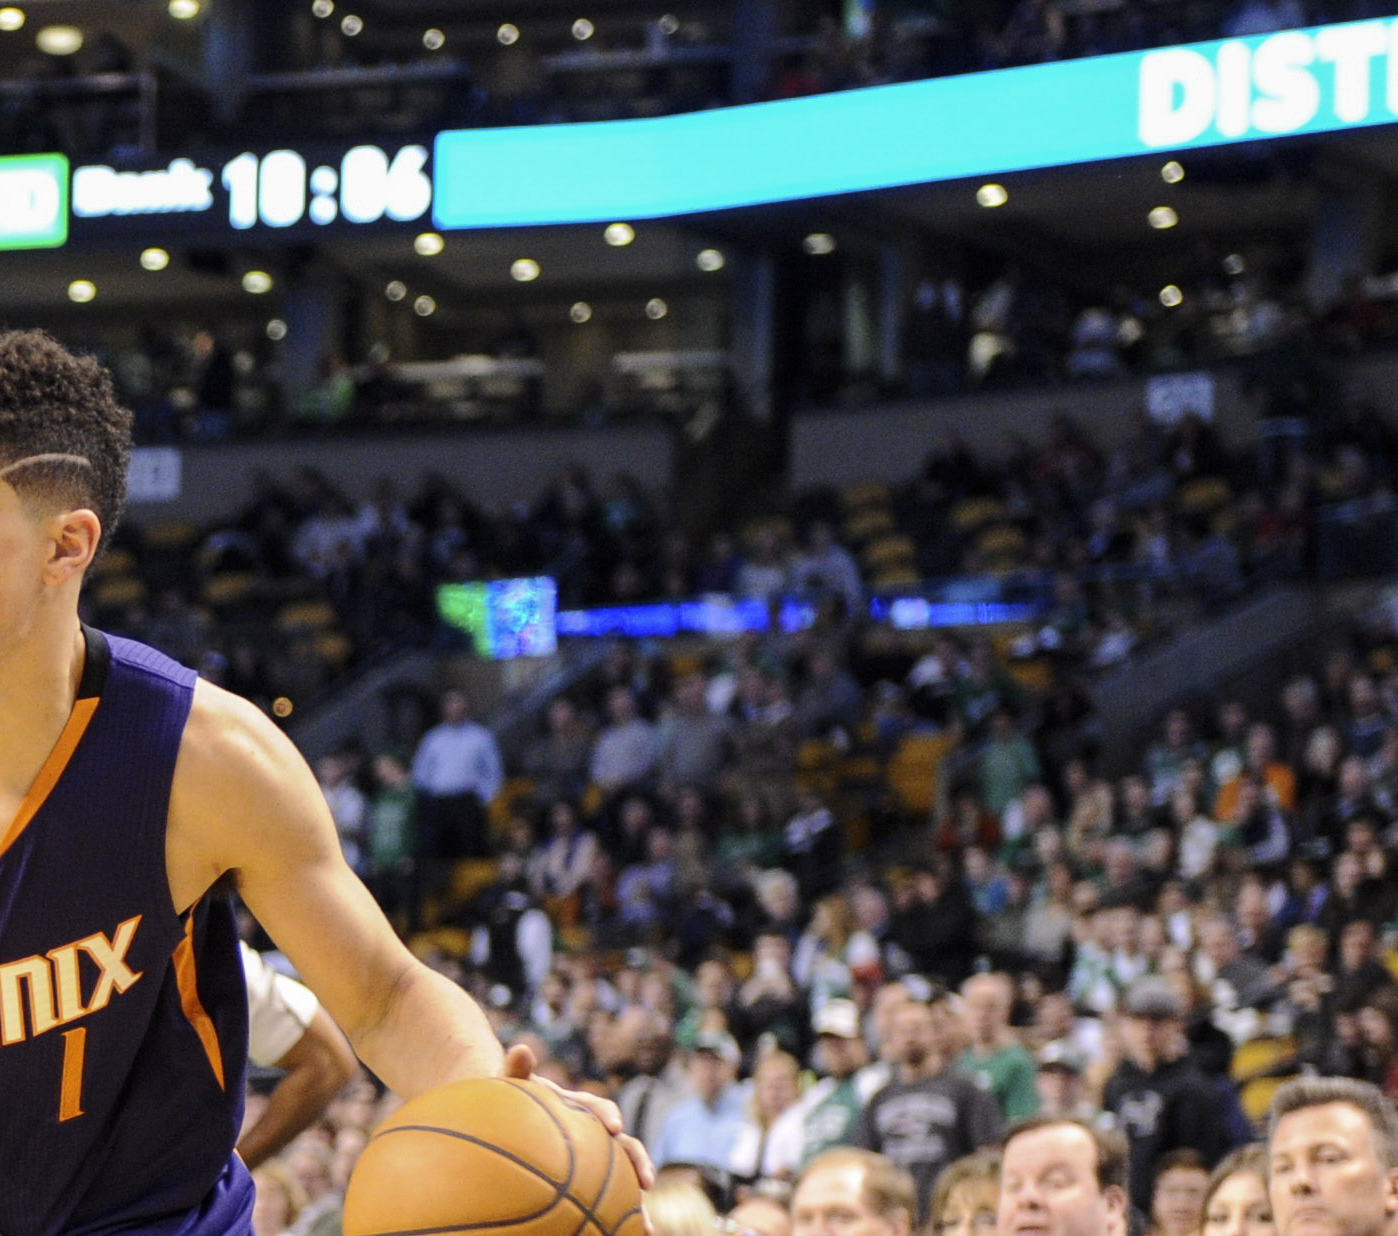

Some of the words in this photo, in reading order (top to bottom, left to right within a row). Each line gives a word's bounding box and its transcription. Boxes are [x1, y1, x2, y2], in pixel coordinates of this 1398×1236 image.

[1138, 20, 1398, 147] DIST
[222, 145, 432, 230] 10:06
[59, 1027, 86, 1122] 1
